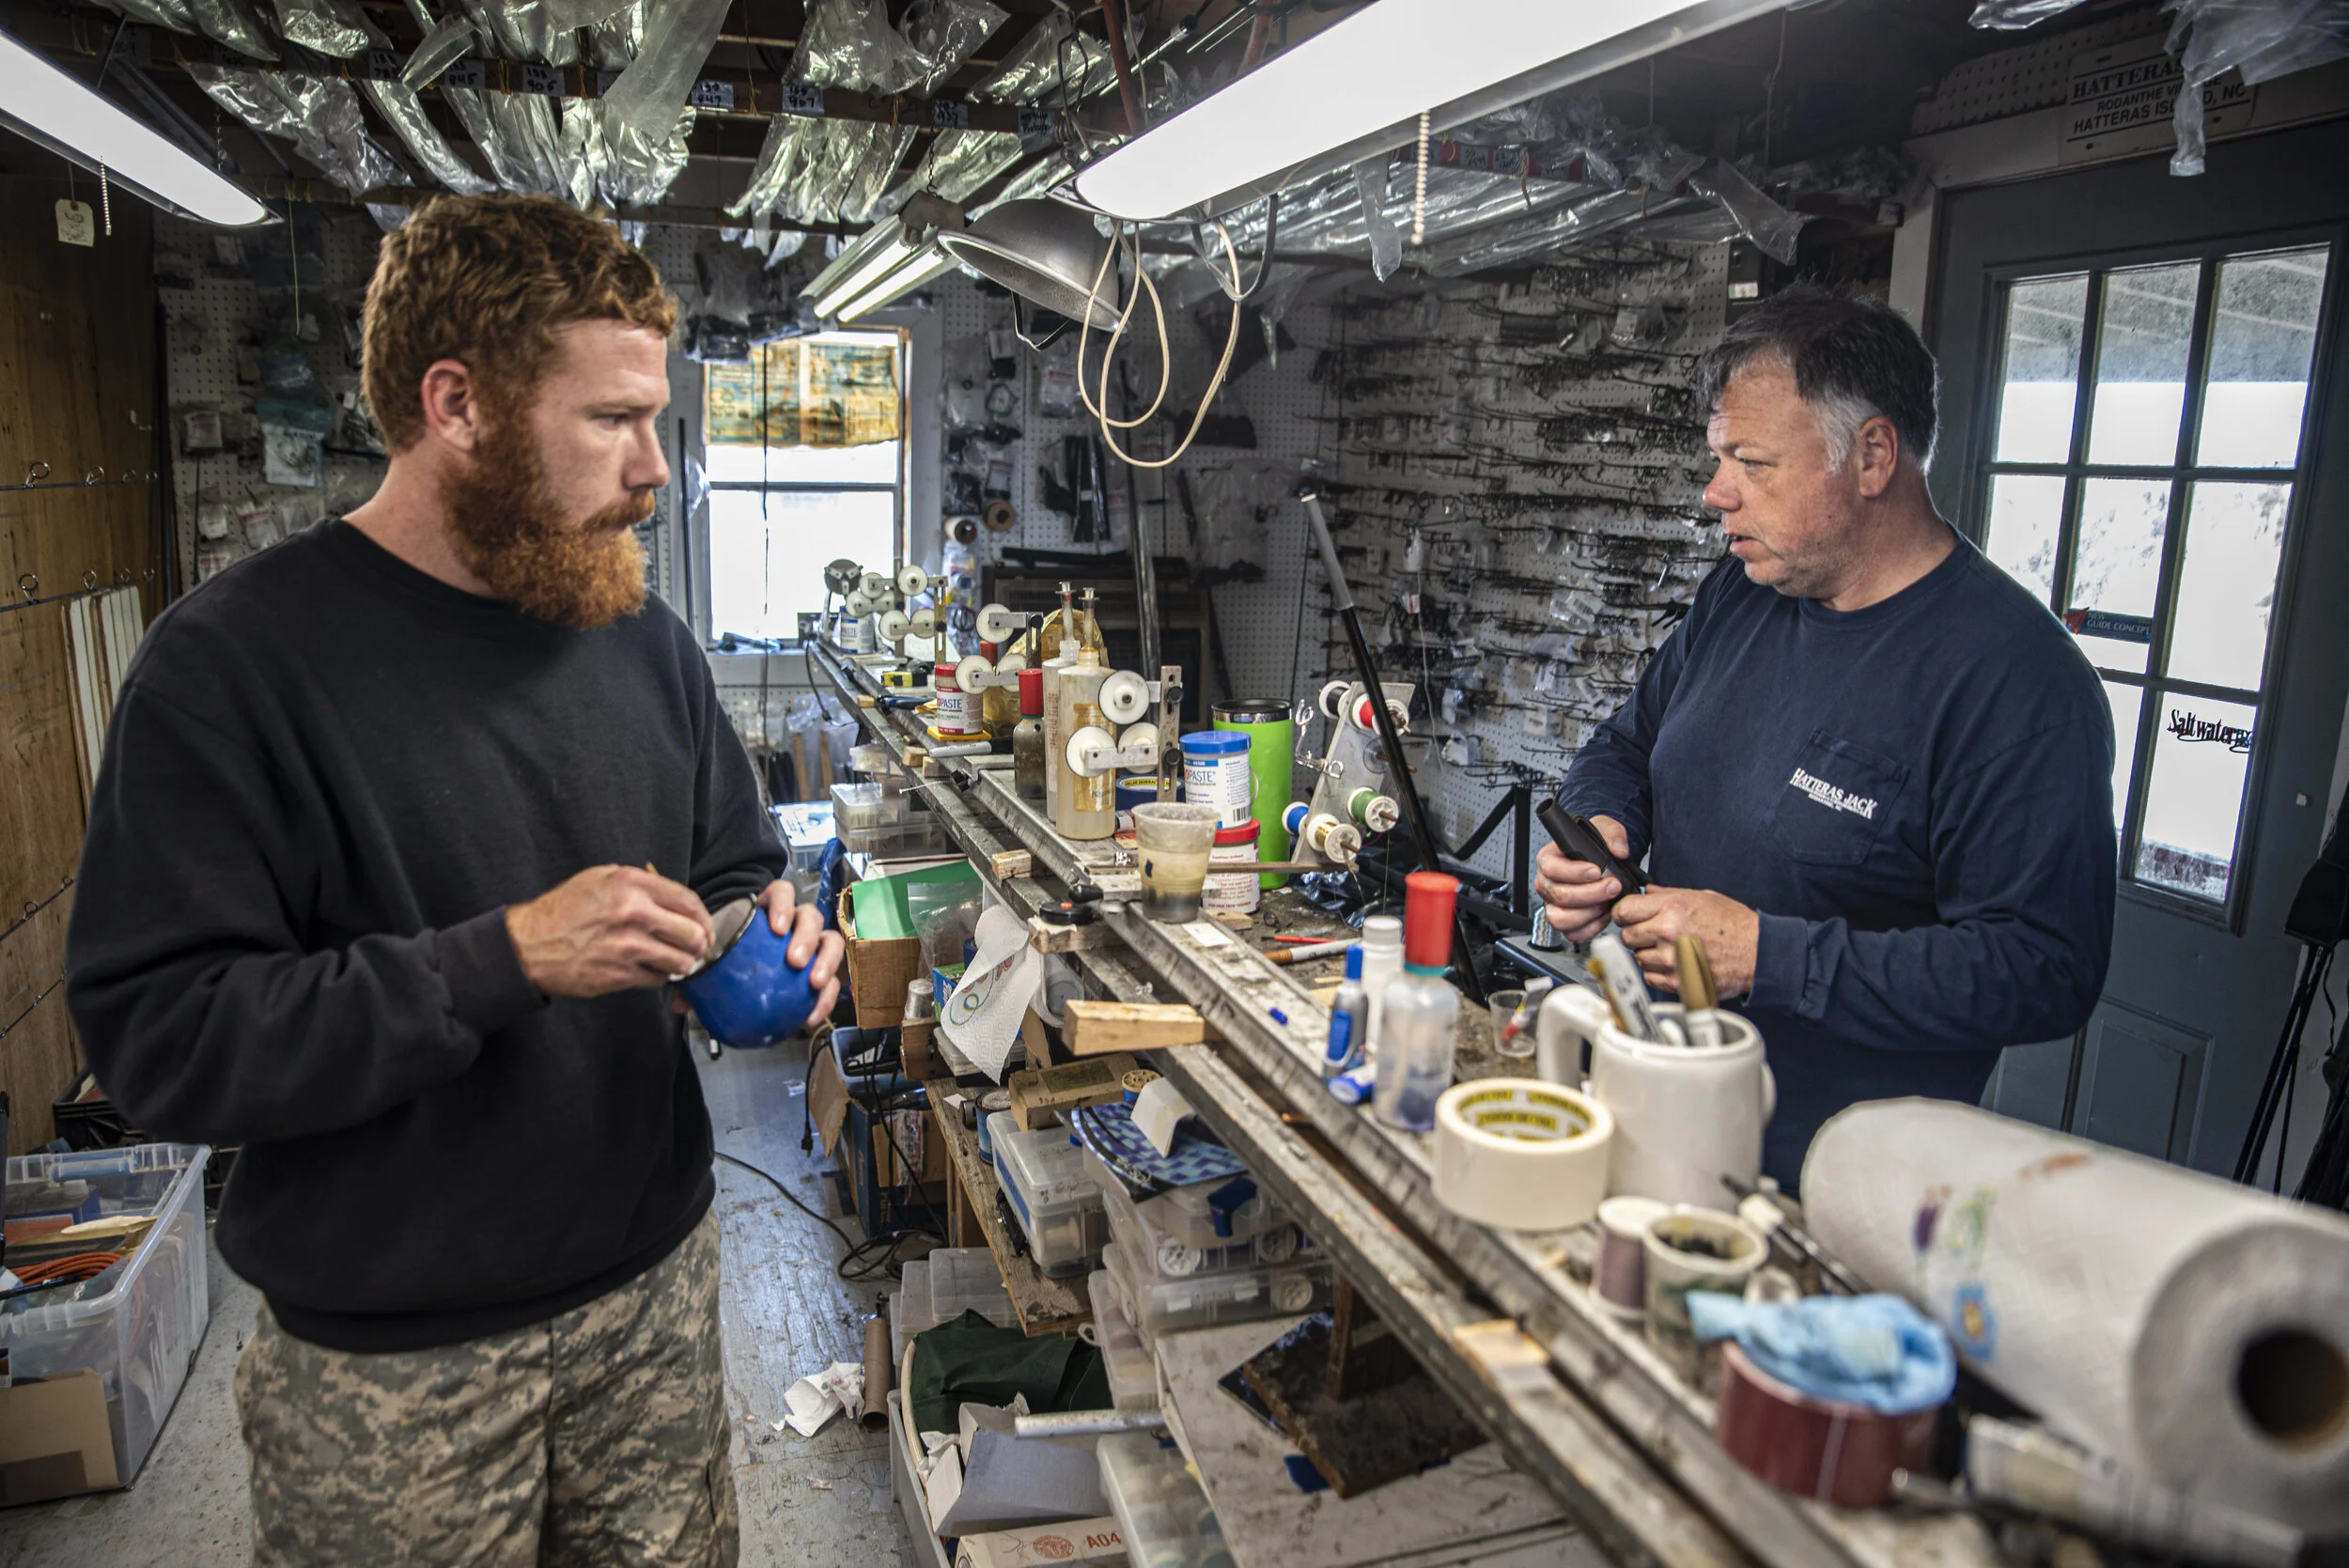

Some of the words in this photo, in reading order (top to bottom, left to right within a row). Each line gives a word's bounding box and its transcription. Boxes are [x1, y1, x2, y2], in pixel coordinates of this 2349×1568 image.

[2074, 105, 2151, 134] HATTERAS
[2222, 82, 2247, 100] NC
[2097, 89, 2161, 112] RODANTHE
[2087, 619, 2111, 629] GUIDE
[2112, 622, 2151, 633] CONCEPT
[2167, 708, 2235, 745] Saltwater
[1789, 768, 1844, 801] HATTERAS
[1843, 792, 1878, 820] JACK
